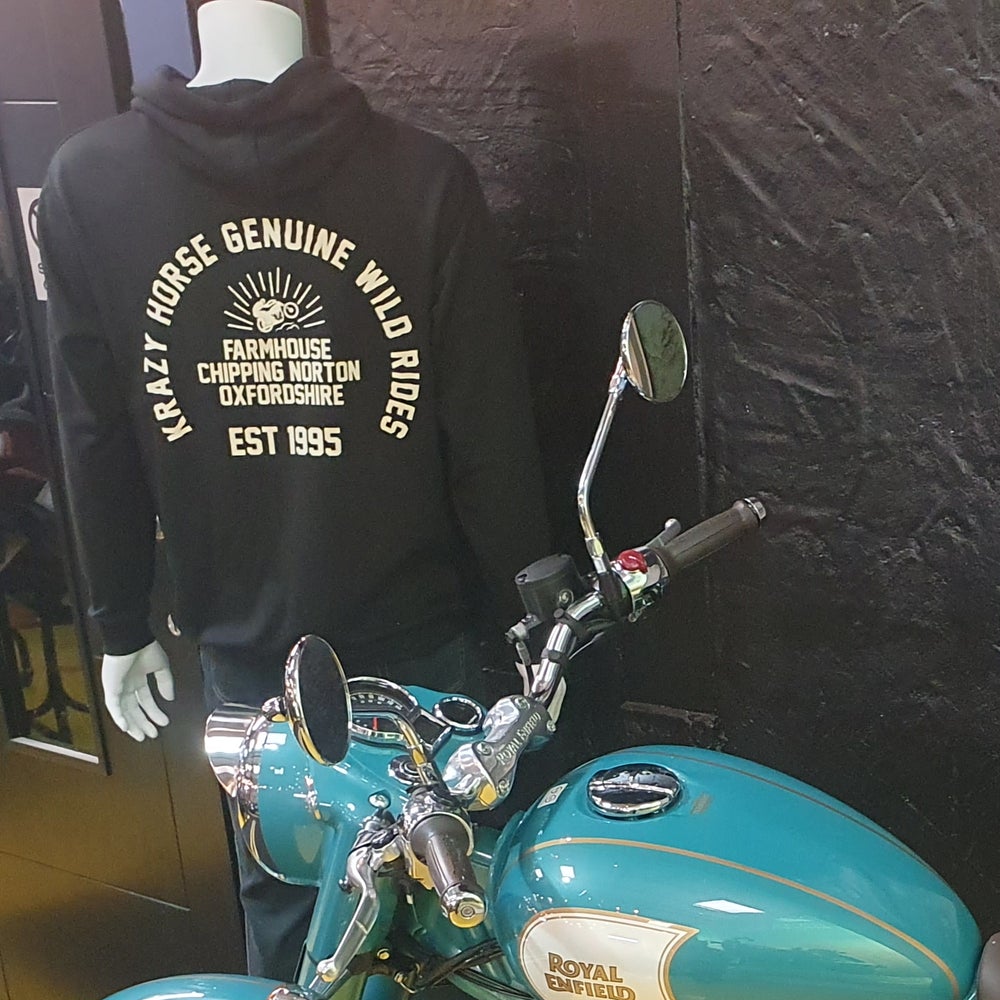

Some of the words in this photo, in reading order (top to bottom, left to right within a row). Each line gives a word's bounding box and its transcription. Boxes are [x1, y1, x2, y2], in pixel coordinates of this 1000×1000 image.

[221, 217, 356, 271] GENUINE
[146, 233, 219, 326] HORSE
[355, 259, 413, 339] WILD
[222, 338, 332, 361] FARMHOUSE
[143, 332, 193, 442] KRAZY
[197, 361, 284, 384] CHIPPING
[289, 360, 361, 383] NORTON
[218, 383, 345, 406] OXFORDSHIRE
[379, 349, 420, 440] RIDES
[228, 426, 278, 456] EST
[286, 426, 342, 457] 1995
[548, 952, 624, 983] ROYAL
